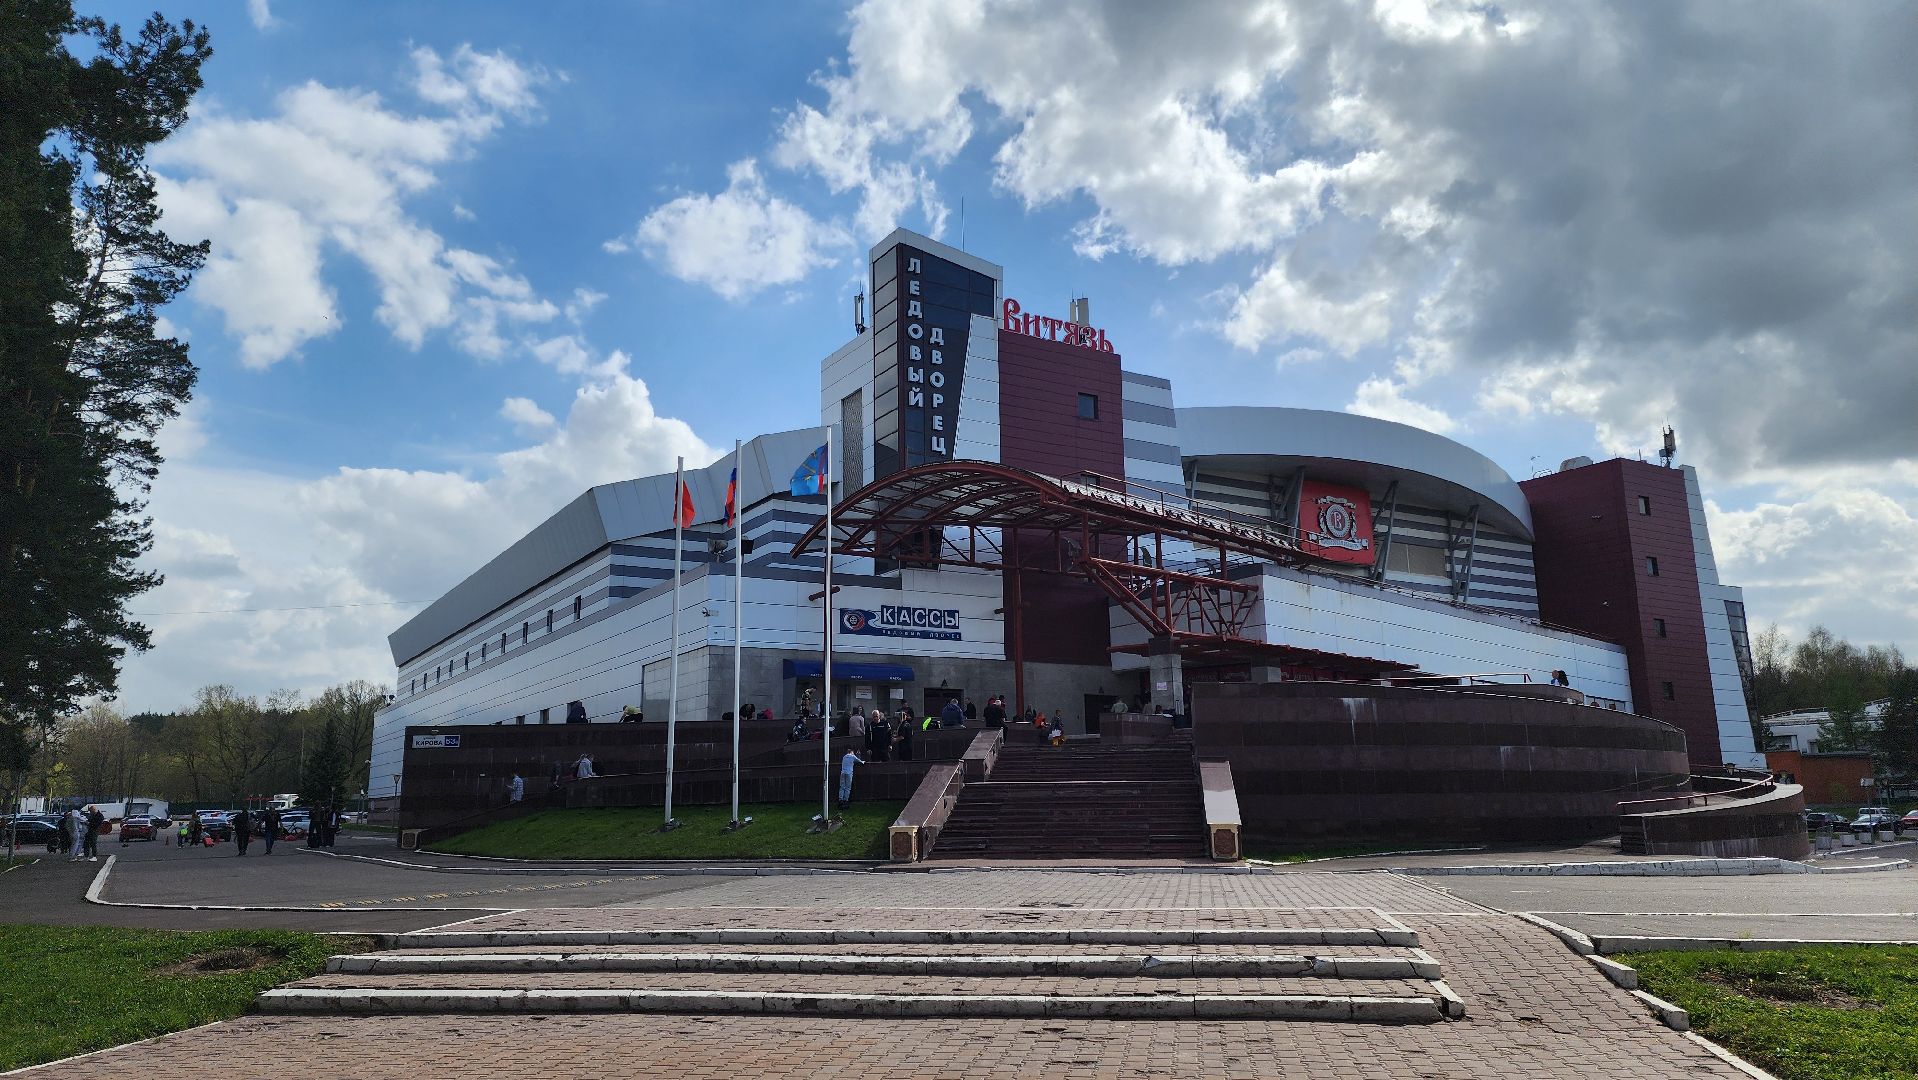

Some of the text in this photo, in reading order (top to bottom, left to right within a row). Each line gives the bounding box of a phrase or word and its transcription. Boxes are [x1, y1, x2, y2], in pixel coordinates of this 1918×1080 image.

[907, 257, 924, 408] ЛЕДОВЫЙ
[929, 327, 947, 455] ДВОРЕЦ
[883, 607, 959, 627] КАССЫ
